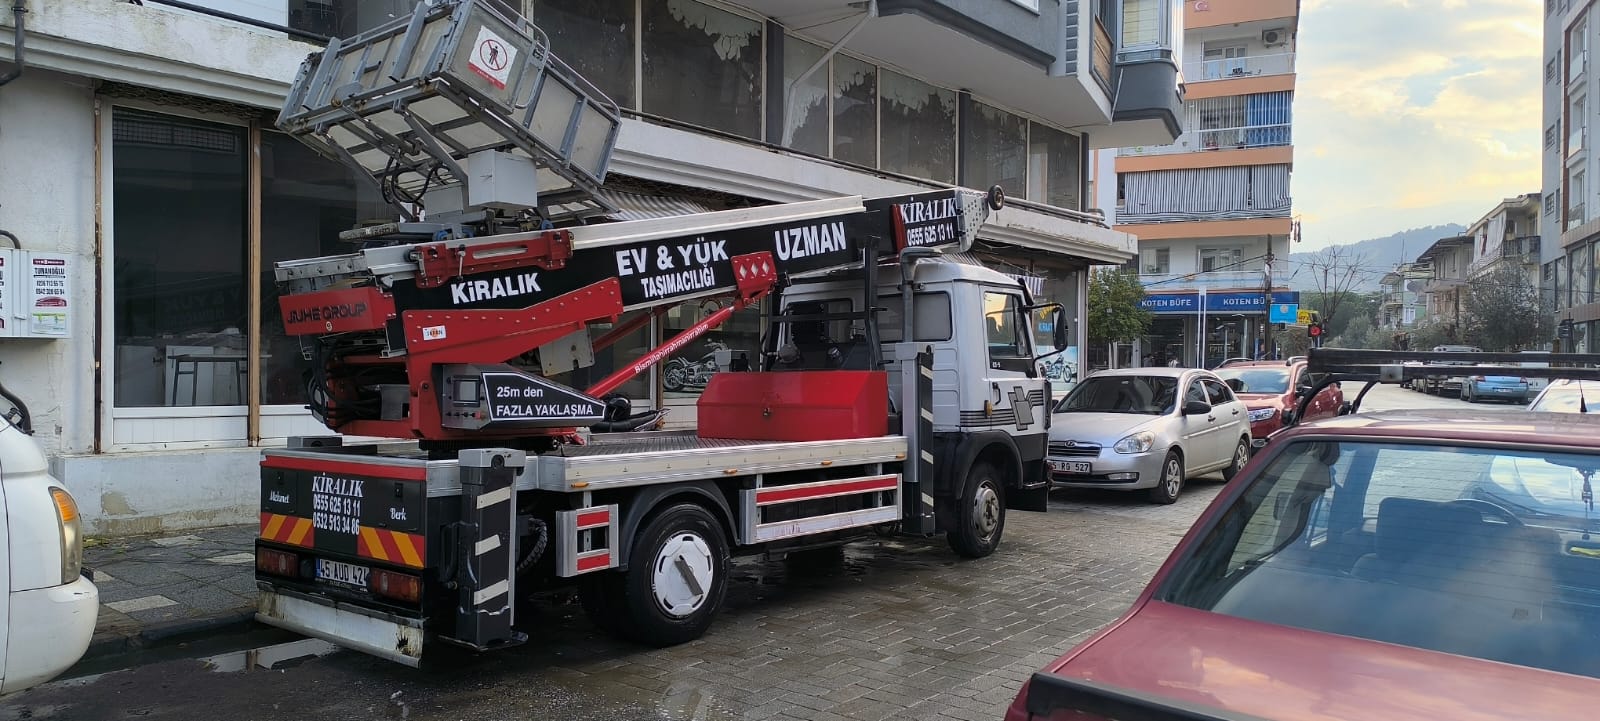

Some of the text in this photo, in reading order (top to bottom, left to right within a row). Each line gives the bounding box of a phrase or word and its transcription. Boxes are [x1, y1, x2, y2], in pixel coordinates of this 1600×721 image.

[899, 196, 957, 224] KİRALIK
[774, 221, 847, 261] UZMAN
[907, 222, 954, 246] 0555 625 13 11
[616, 236, 729, 276] EV & YÜK
[640, 263, 716, 299] TAŞIMACILIĞI
[322, 302, 368, 320] GROUP
[1141, 298, 1192, 307] KOTEN BÜFE
[496, 386, 543, 398] 25m den
[496, 404, 594, 417] FAZLA YAKLAŞMA
[1061, 462, 1071, 471] RG
[1075, 463, 1089, 472] 527
[312, 472, 364, 498] KİRALIK
[313, 493, 361, 518] 0555 625 13 11
[390, 507, 406, 520] Berk
[312, 512, 360, 535] 0532 513 34 86
[320, 560, 330, 578] 45
